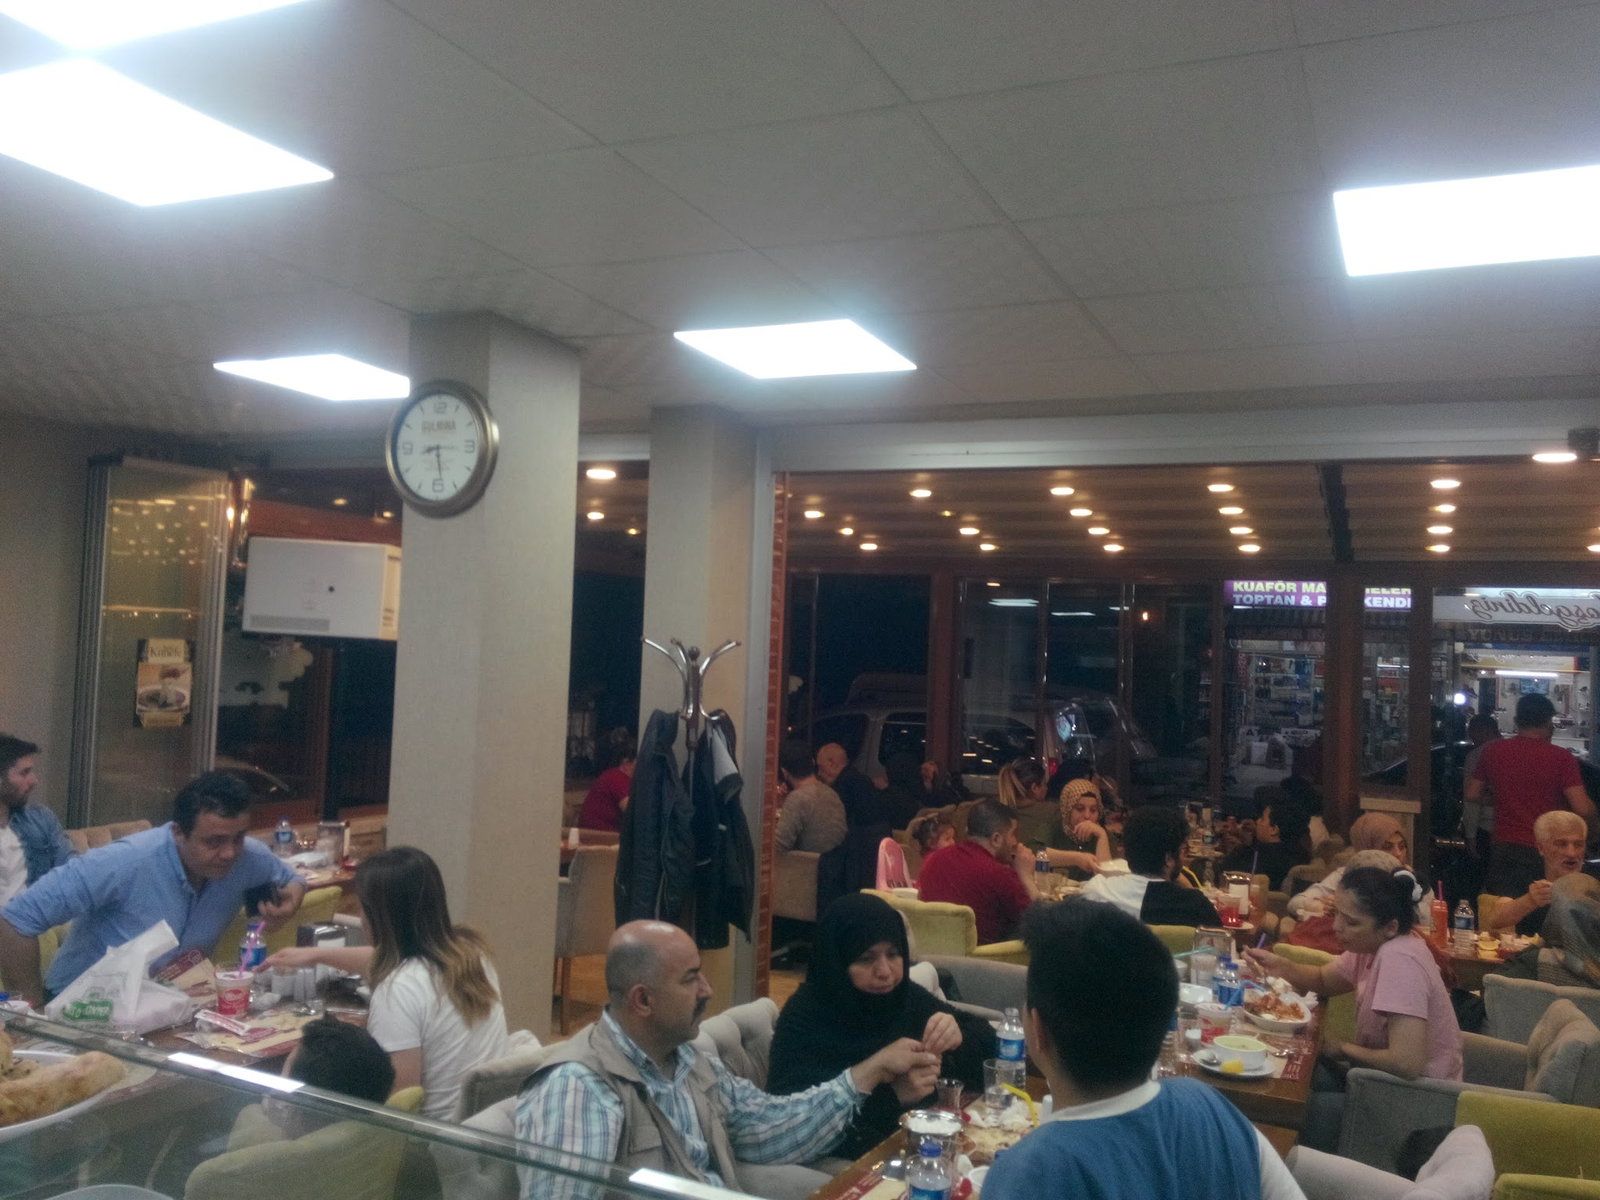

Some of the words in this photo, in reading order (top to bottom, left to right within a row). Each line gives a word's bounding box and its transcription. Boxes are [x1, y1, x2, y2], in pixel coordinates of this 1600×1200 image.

[403, 442, 413, 455] 9
[464, 440, 475, 454] 3
[432, 479, 444, 492] 6
[1233, 581, 1297, 592] KUAFÖR
[1233, 594, 1296, 605] TOPTAN
[1301, 595, 1312, 606] &
